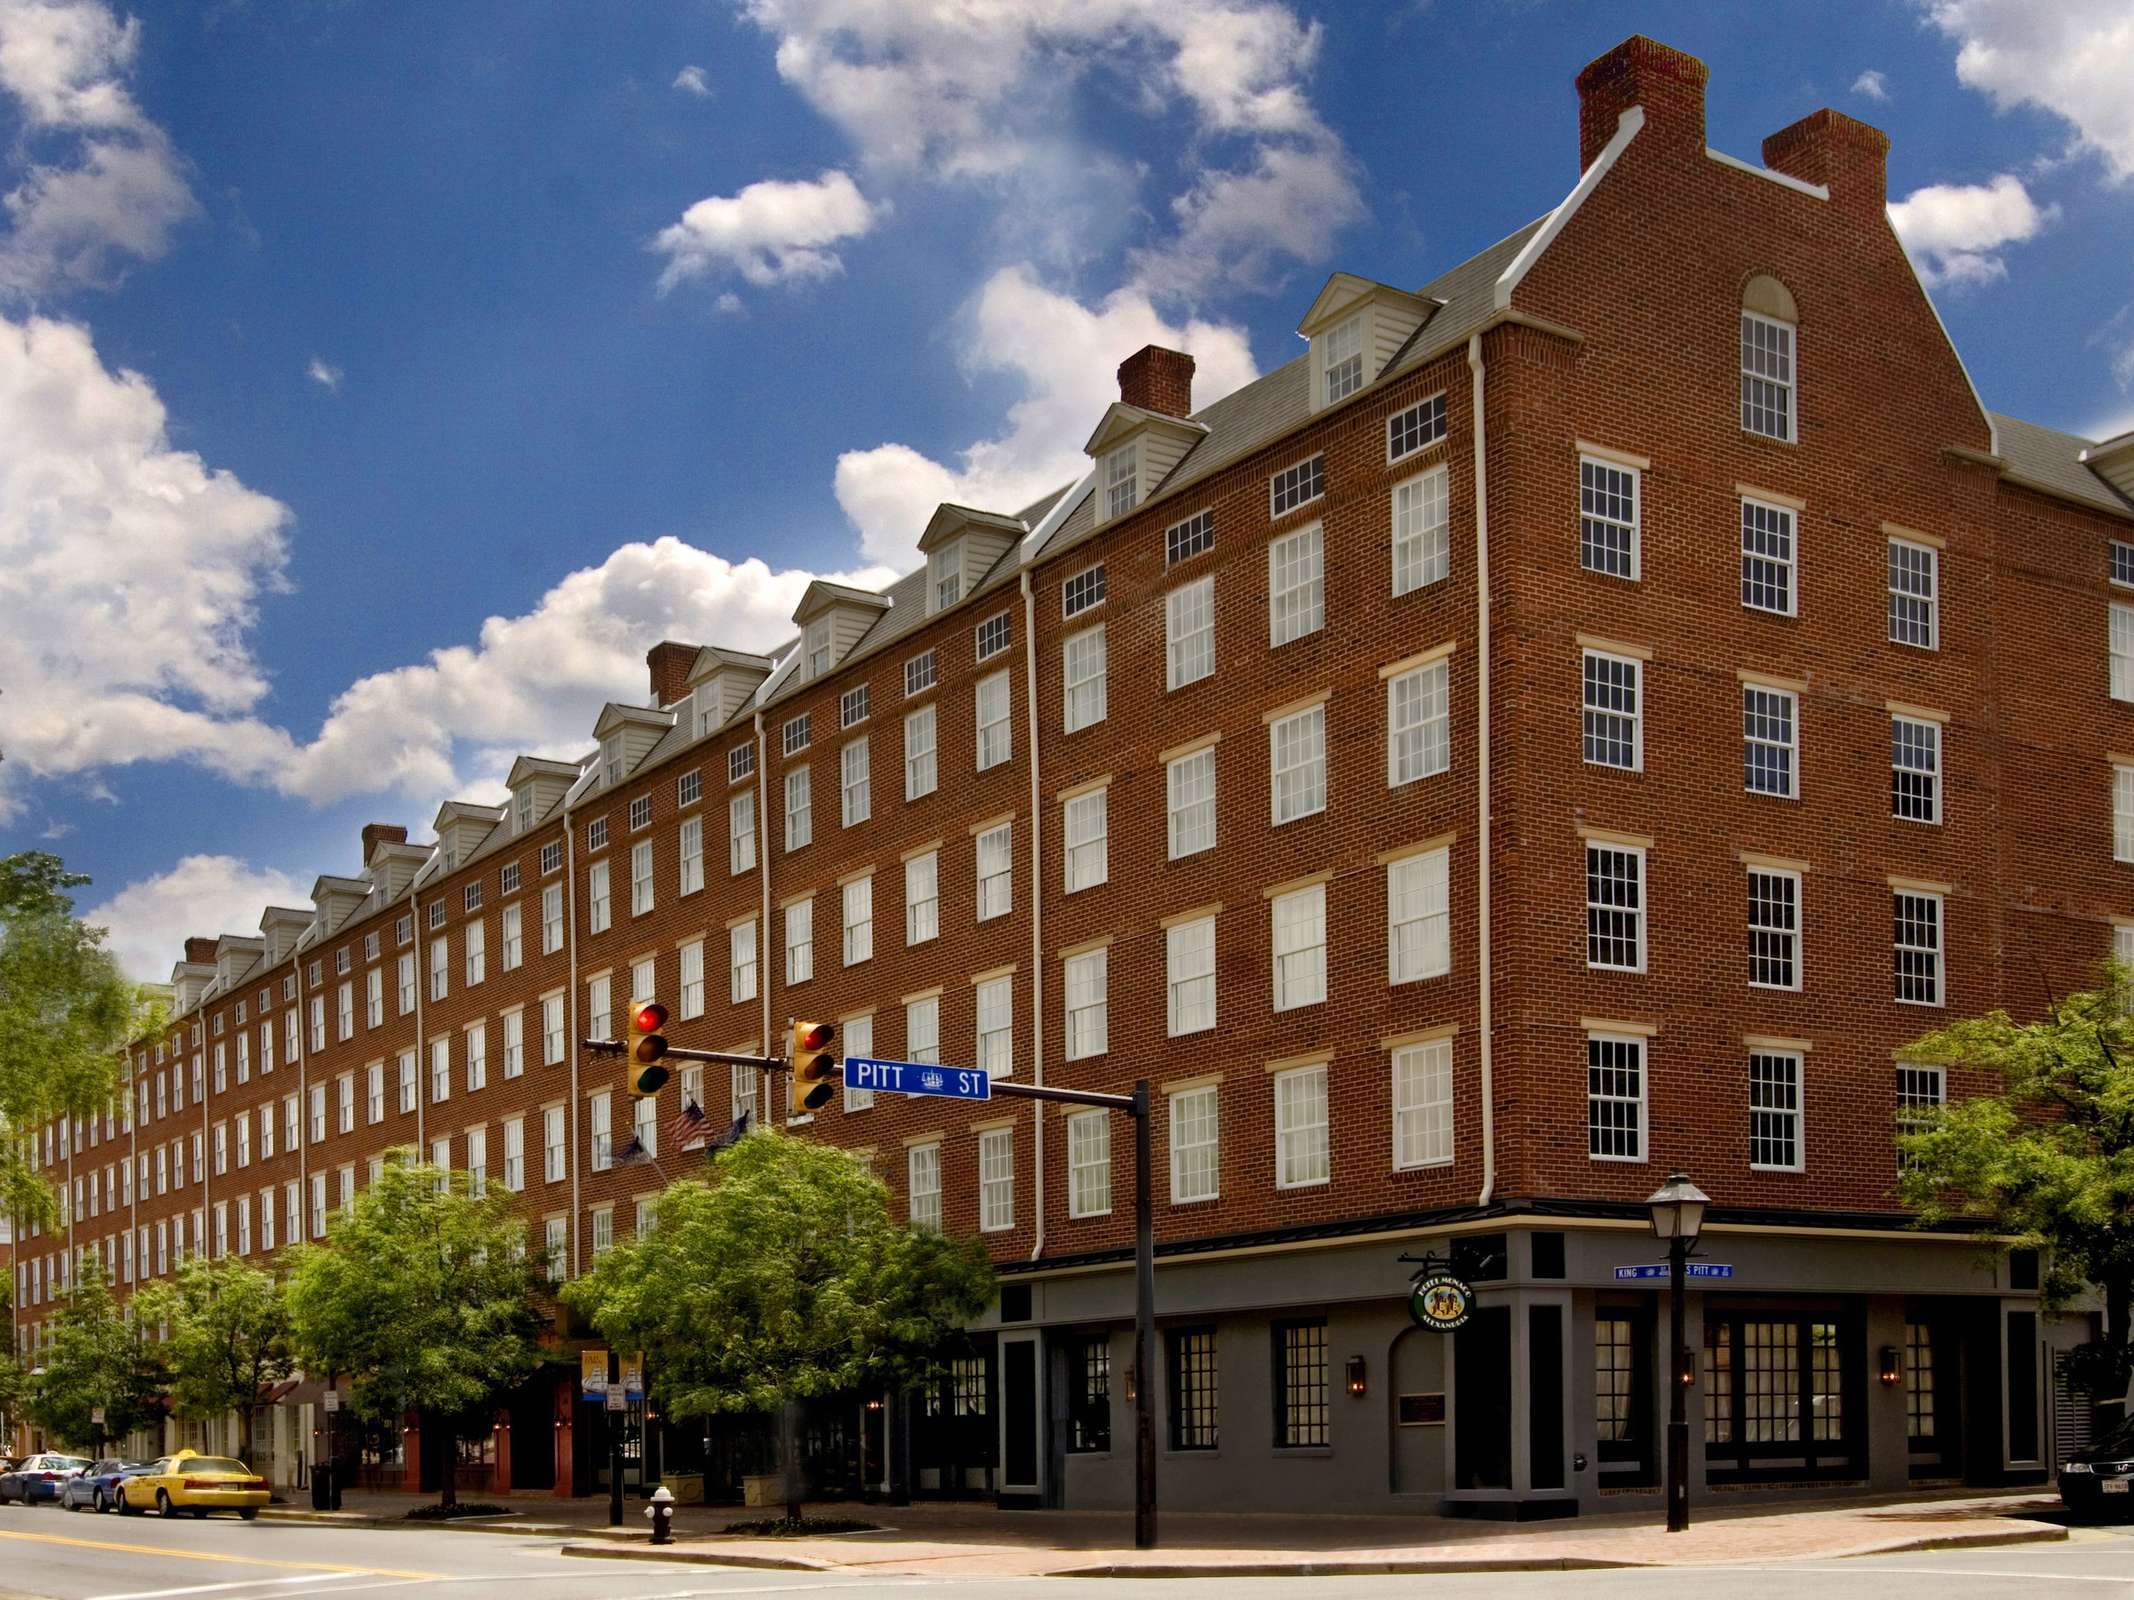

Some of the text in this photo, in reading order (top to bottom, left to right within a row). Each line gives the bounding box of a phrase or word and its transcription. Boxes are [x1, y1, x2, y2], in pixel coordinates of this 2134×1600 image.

[857, 1063, 981, 1095] PITT ST
[1618, 1268, 1638, 1278] KING
[1686, 1264, 1691, 1275] S
[1693, 1265, 1709, 1276] PITT
[1418, 1277, 1472, 1297] HOTEL MONACO
[1423, 1314, 1469, 1329] ALEXANDRIA
